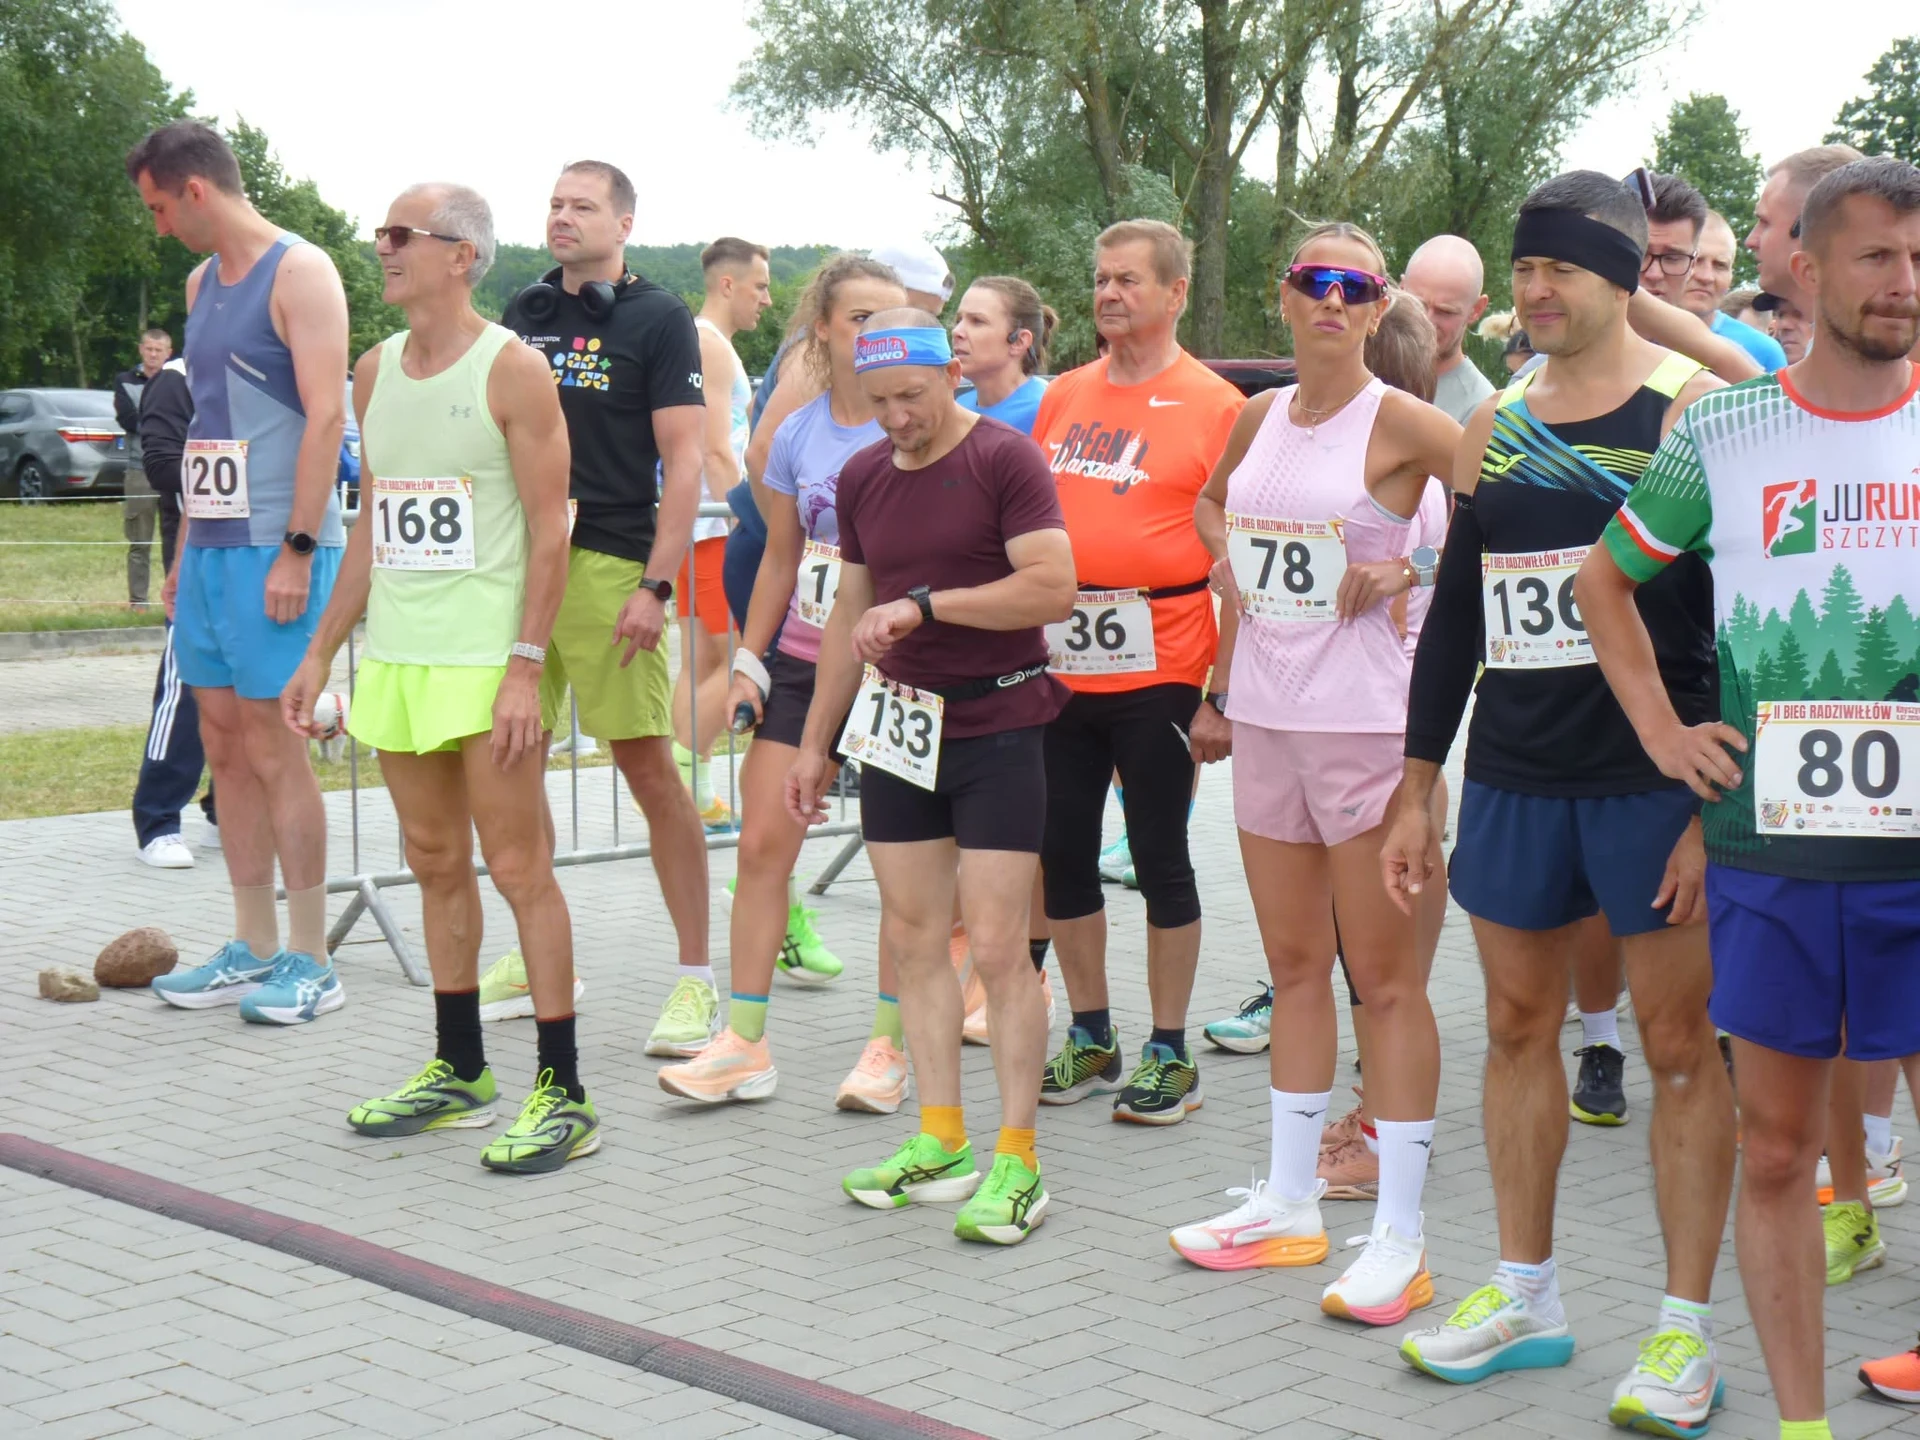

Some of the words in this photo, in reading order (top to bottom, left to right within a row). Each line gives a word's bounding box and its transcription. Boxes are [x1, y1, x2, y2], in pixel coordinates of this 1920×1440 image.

[185, 456, 238, 496] 120
[378, 497, 462, 544] 168
[1241, 517, 1255, 530] BIEG
[1256, 520, 1304, 535] RADZIWIŁŁÓW
[820, 545, 832, 557] BIEG
[1250, 537, 1314, 594] 78
[1506, 551, 1560, 569] RADZIWIŁŁÓW
[811, 563, 837, 604] 1
[1065, 607, 1127, 651] 36
[870, 692, 933, 758] 133
[1774, 704, 1781, 719] II
[1784, 704, 1806, 719] BIEG
[1810, 702, 1892, 720] RADZIWIŁŁÓW
[1797, 729, 1900, 799] 80
